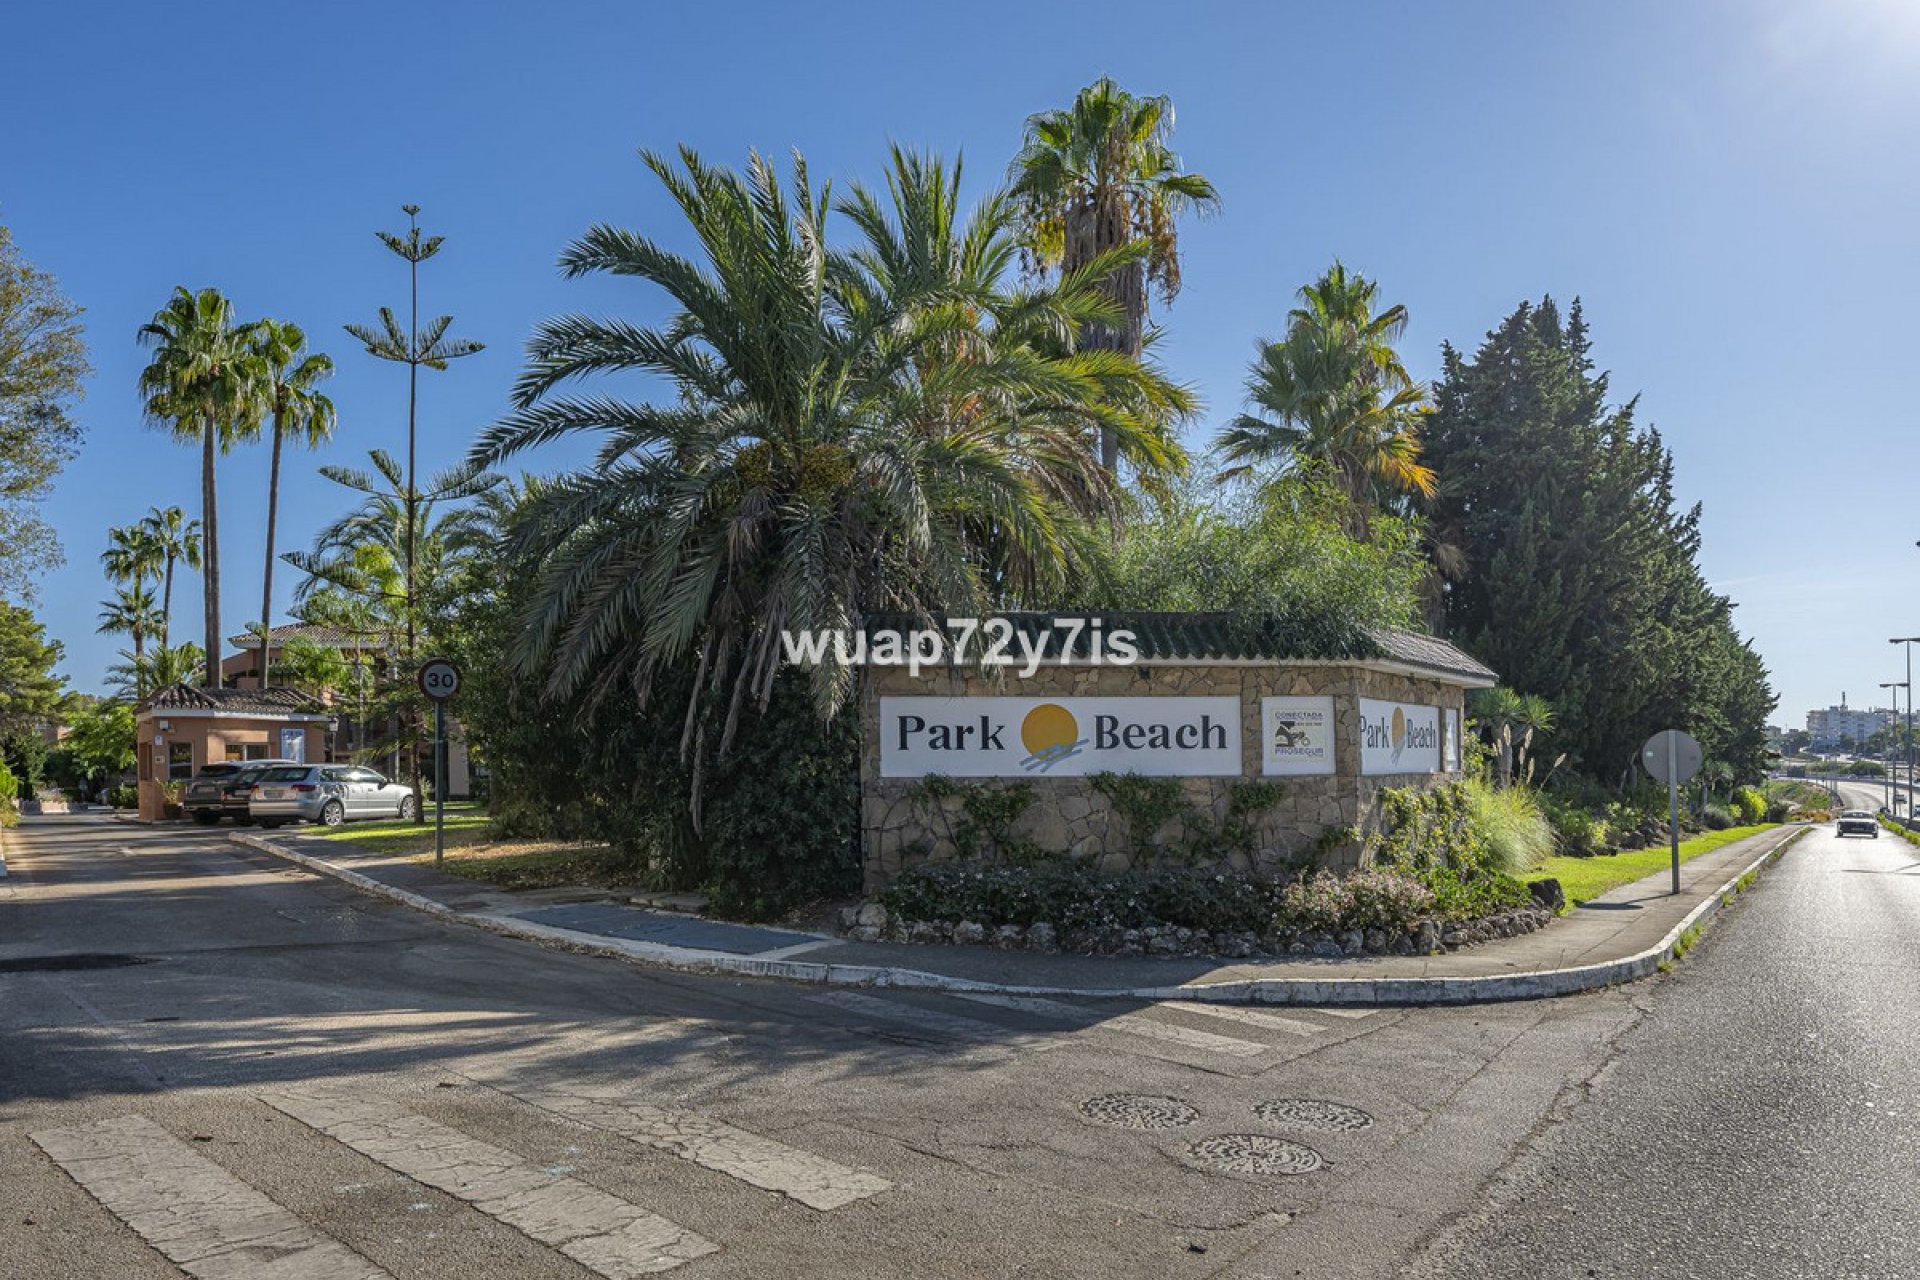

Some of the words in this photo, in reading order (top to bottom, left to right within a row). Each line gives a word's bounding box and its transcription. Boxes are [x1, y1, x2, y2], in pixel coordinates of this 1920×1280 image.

[428, 672, 454, 688] 30
[897, 715, 1006, 751] Park
[1094, 715, 1228, 750] Beach
[1360, 715, 1390, 749] Park
[1406, 718, 1437, 749] Beach
